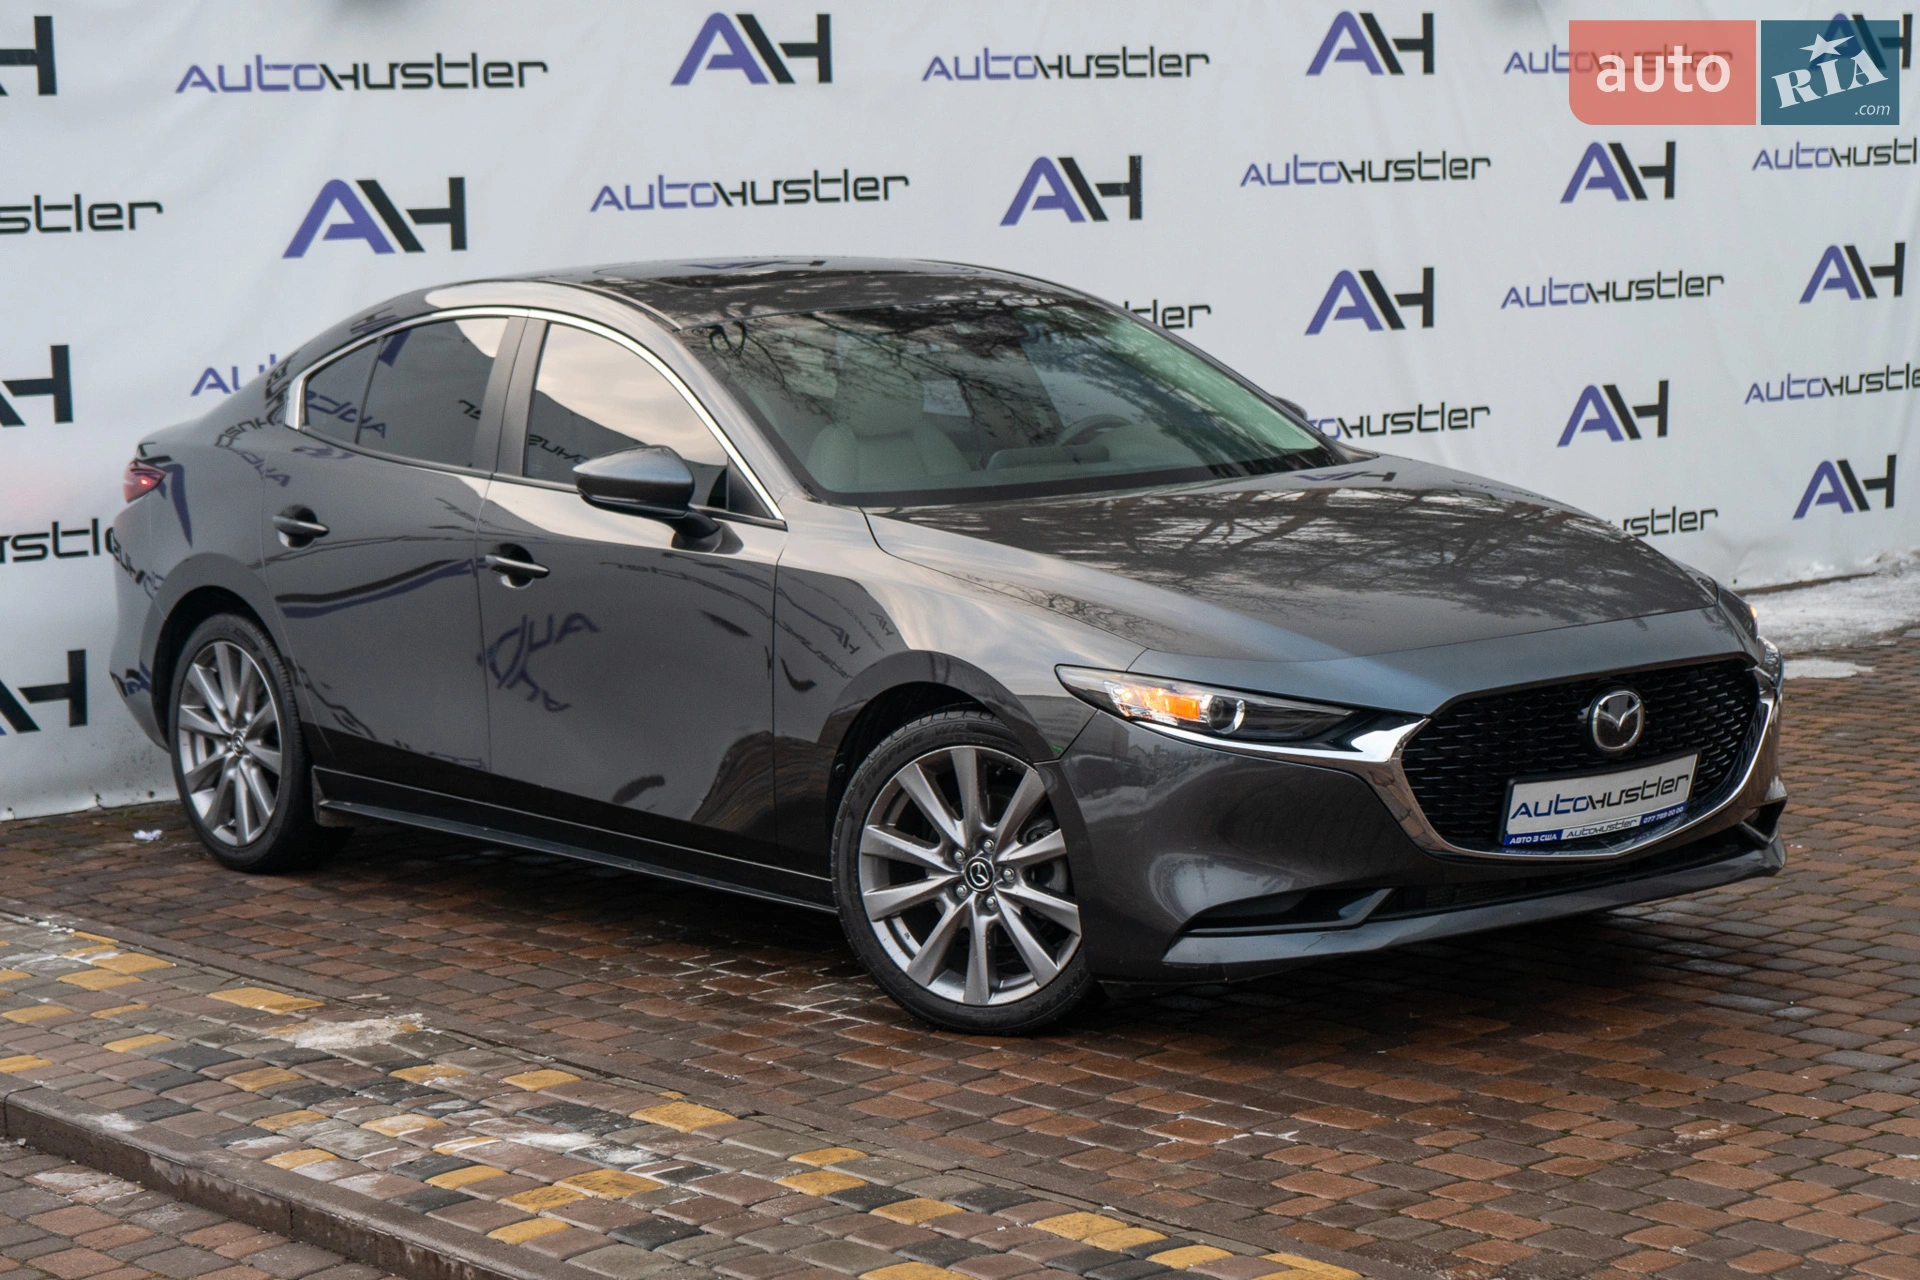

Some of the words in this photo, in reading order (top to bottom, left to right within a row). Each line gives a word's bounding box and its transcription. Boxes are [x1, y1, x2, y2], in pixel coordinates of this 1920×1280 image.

[671, 12, 833, 86] AH
[1306, 11, 1435, 76] AH
[1000, 155, 1143, 226] AH
[1560, 141, 1676, 204] AH
[282, 176, 467, 259] AH
[1305, 267, 1434, 336] AH
[1800, 242, 1906, 304] AH
[1309, 402, 1490, 441] oHustler
[1557, 380, 1669, 447] AH
[1793, 454, 1898, 520] AH
